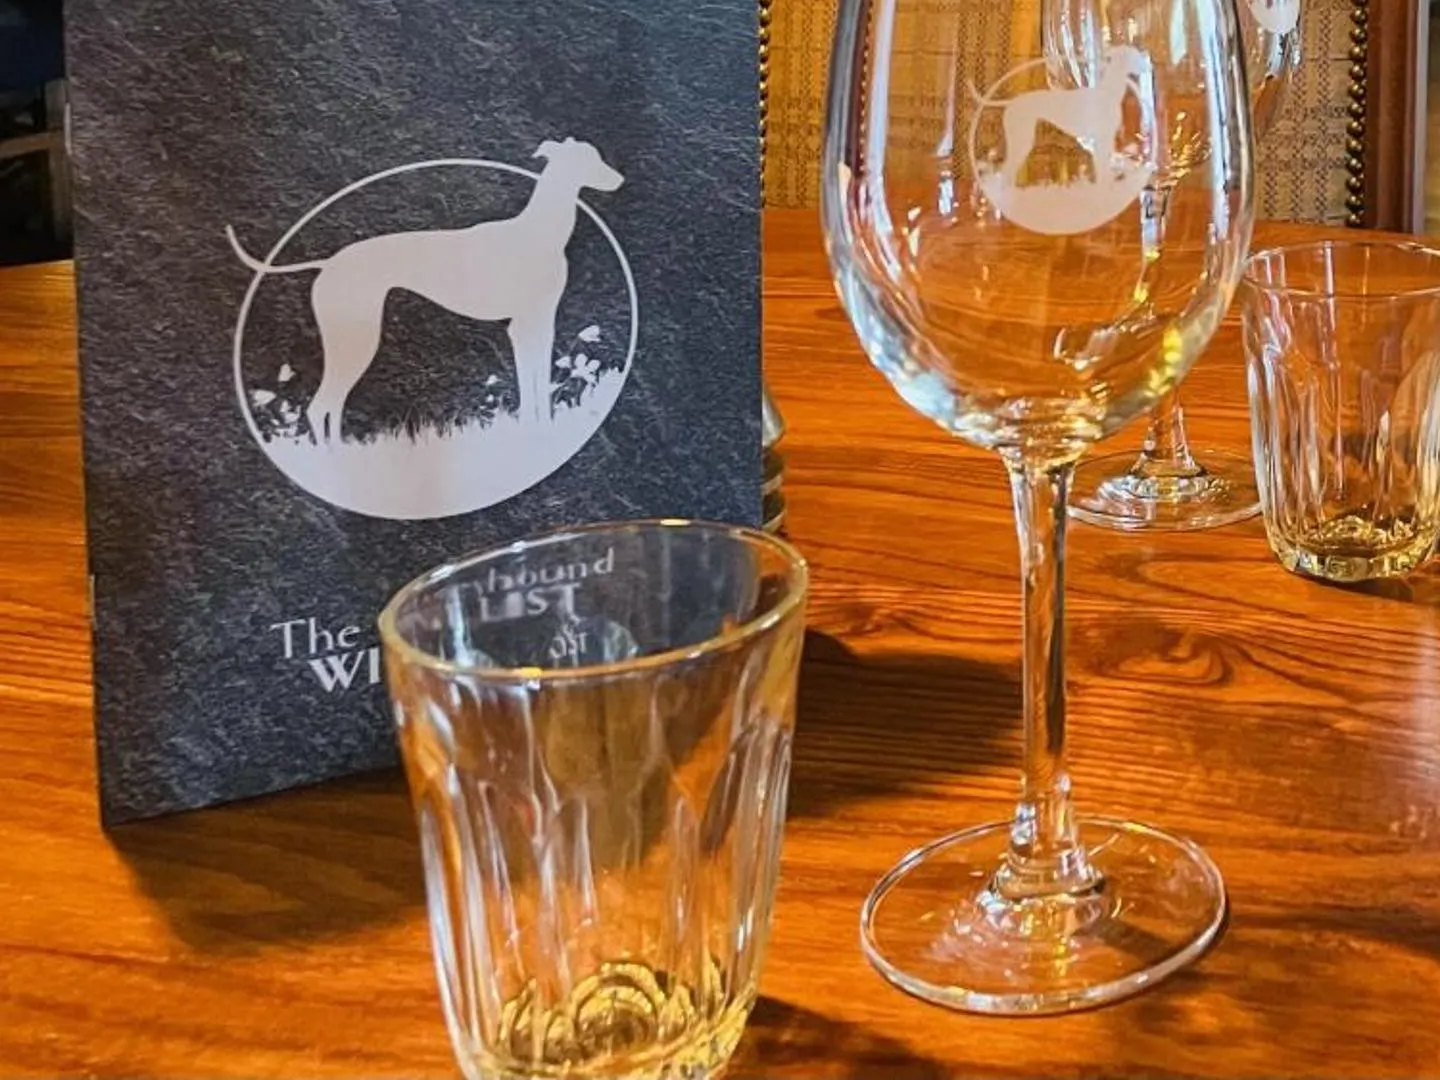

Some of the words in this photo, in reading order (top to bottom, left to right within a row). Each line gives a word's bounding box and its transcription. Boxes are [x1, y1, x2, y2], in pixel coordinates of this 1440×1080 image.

[270, 617, 361, 659] The
[476, 547, 615, 593] hound
[308, 647, 380, 693] WI
